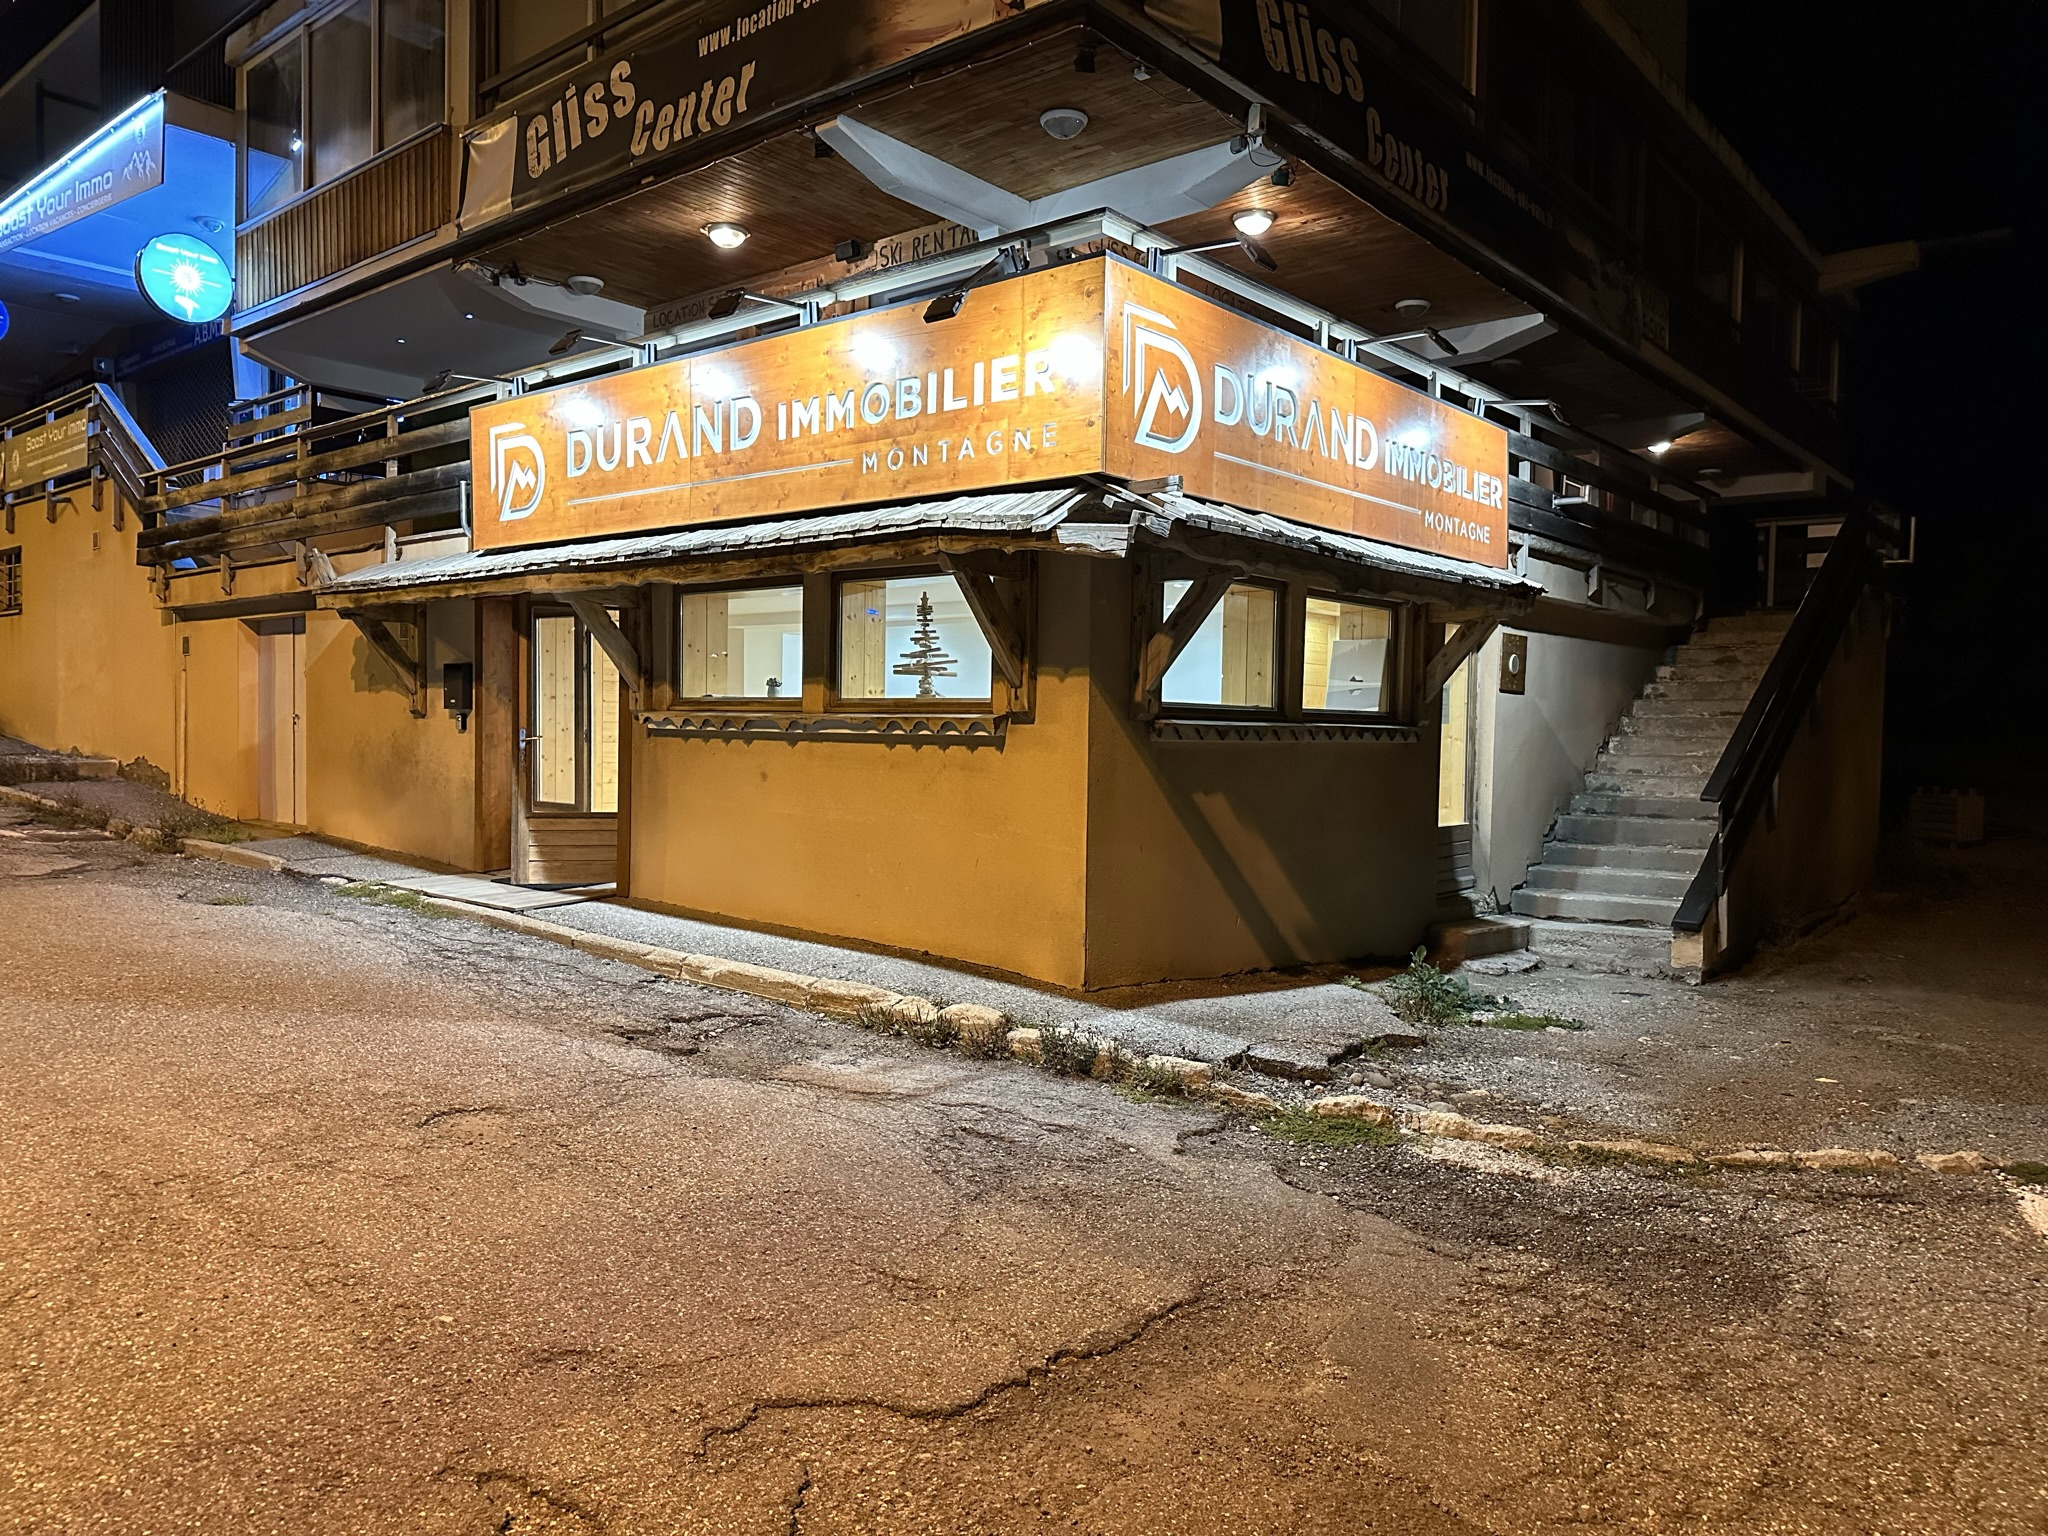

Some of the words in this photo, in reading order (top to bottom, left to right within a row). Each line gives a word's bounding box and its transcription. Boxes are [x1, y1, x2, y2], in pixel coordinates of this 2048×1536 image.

[698, 0, 820, 58] www.location-
[0, 202, 33, 237] oost
[37, 189, 72, 219] Your
[75, 171, 113, 203] Immo
[26, 431, 47, 452] Boost
[48, 426, 67, 443] Your
[67, 418, 86, 436] Immo
[566, 397, 762, 479] DURAND
[777, 349, 1056, 442] IMMOBILIER
[1214, 363, 1379, 471] DURAND
[1384, 438, 1503, 510] IMMOBILIER
[863, 422, 1057, 475] MONTAGNE
[1424, 511, 1491, 545] MONTAGNE
